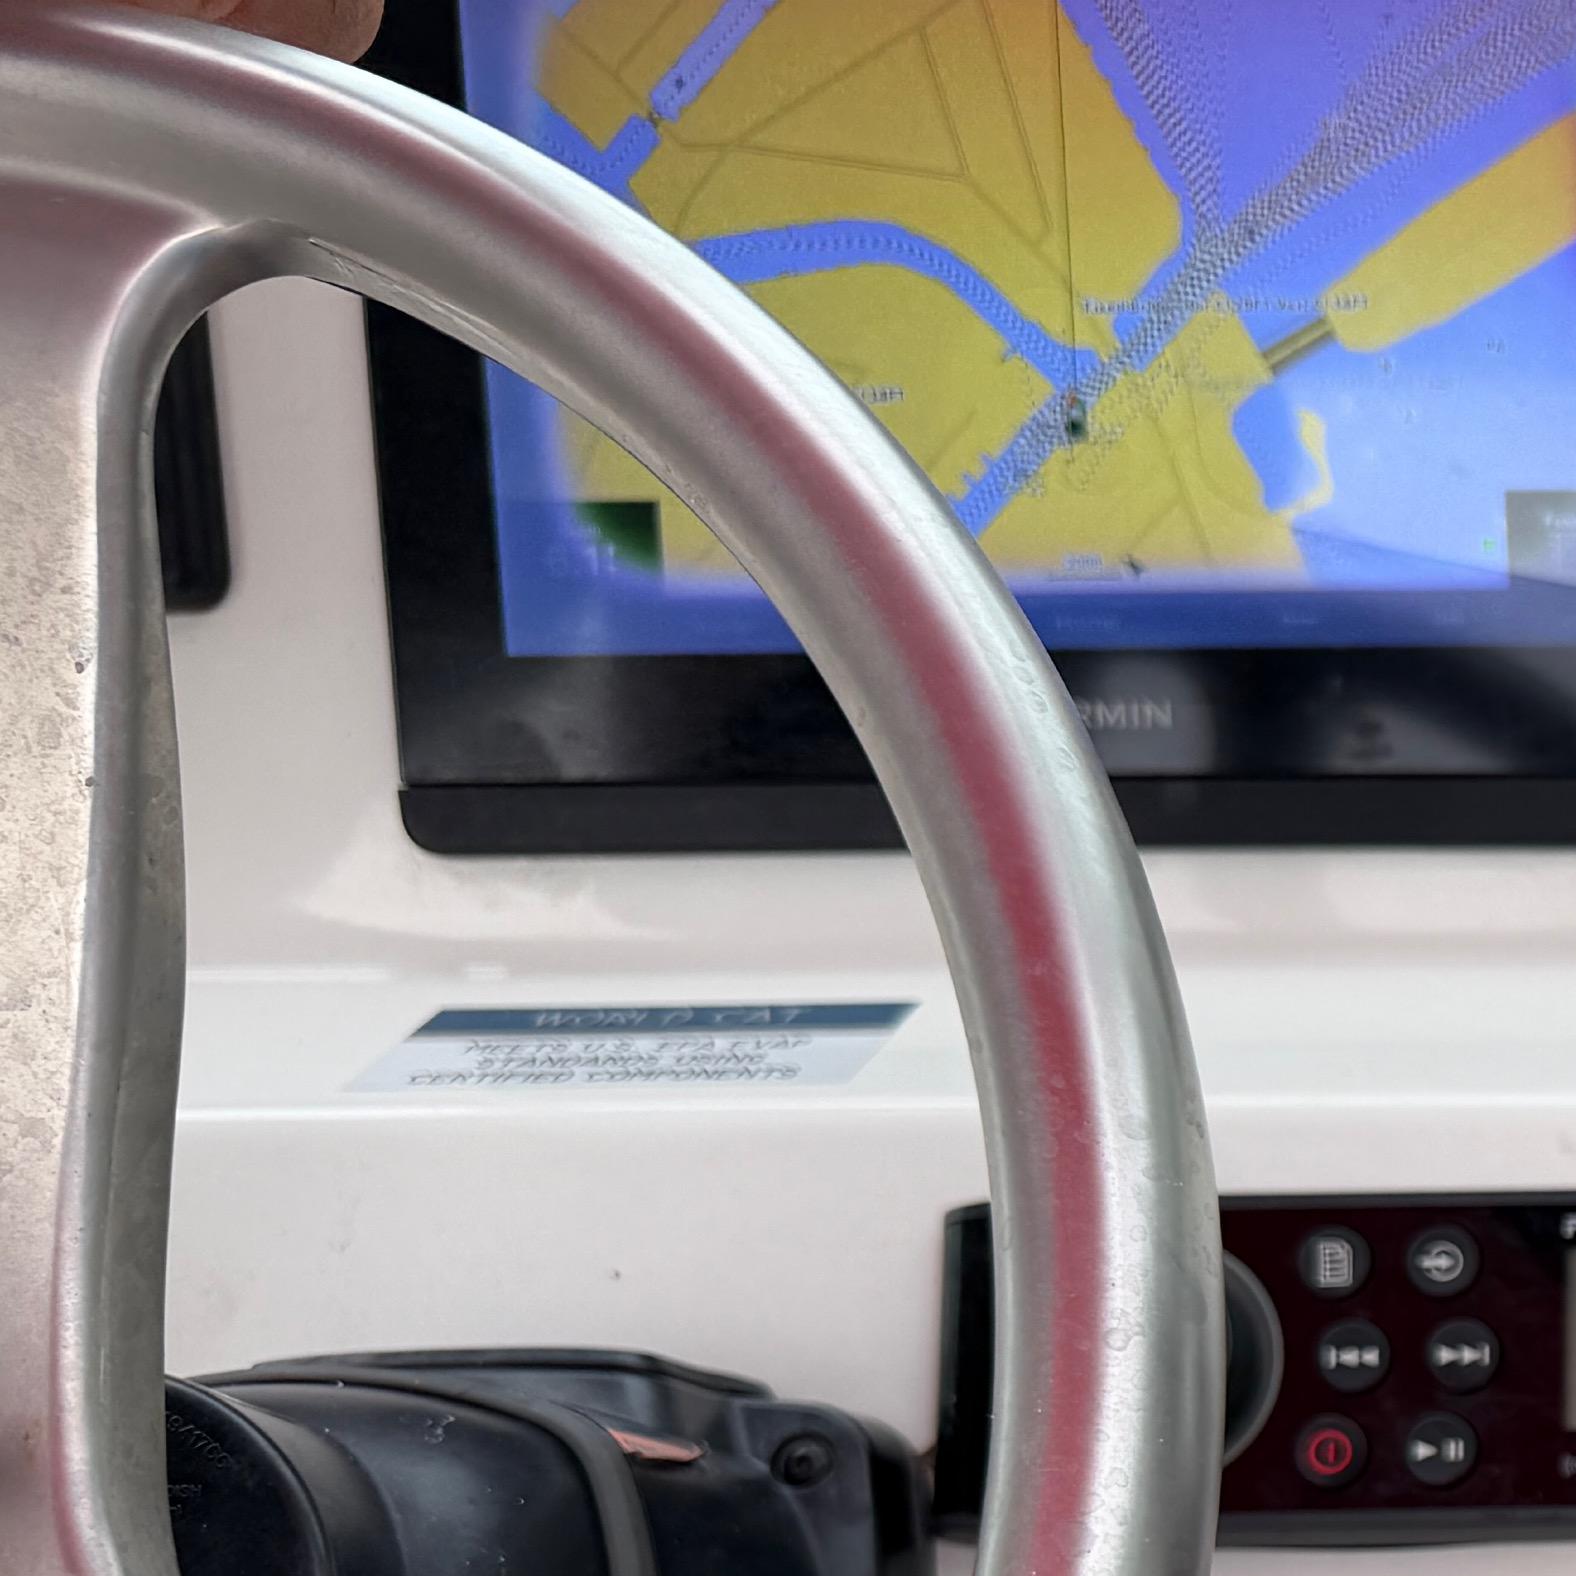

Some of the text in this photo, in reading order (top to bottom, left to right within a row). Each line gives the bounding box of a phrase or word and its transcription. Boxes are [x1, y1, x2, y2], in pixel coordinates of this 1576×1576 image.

[1082, 700, 1173, 730] RMIN
[714, 1007, 802, 1024] CAT
[405, 1064, 802, 1086] CERTIFIED COMPONENTS
